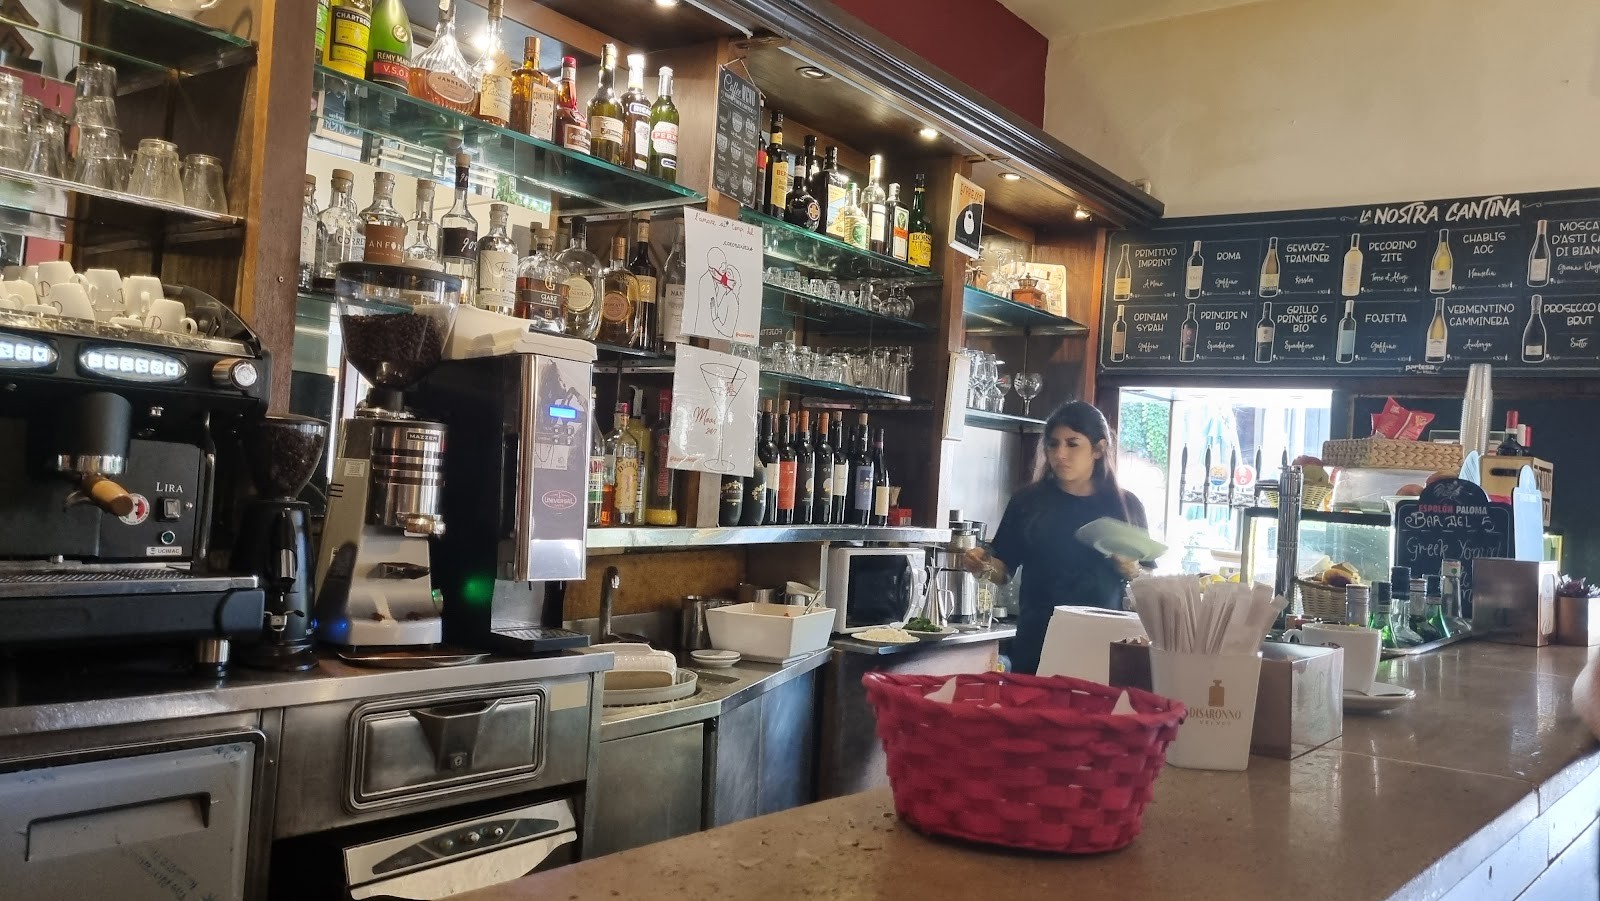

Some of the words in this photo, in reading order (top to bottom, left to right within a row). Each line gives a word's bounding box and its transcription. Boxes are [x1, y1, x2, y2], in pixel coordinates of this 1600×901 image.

[336, 12, 370, 27] CHARTRE
[377, 51, 396, 61] RÉMY
[1359, 210, 1372, 224] LA
[1374, 201, 1439, 225] NOSTRA
[1445, 195, 1521, 222] CANTINA
[1559, 221, 1600, 231] MOSCA
[337, 235, 365, 247] CORRE
[912, 233, 931, 242] BORS
[1462, 232, 1506, 244] CHABLIS
[1551, 233, 1587, 245] D'ASTI
[1368, 240, 1417, 251] PECORINO
[1473, 244, 1494, 255] AOC
[1135, 247, 1178, 258] PRIMITIVO
[1216, 252, 1241, 260] ROMA
[1556, 247, 1569, 257] DI
[1572, 246, 1600, 256] BIAN
[1138, 258, 1172, 268] IMPRINT
[1284, 253, 1330, 263] TRAMINER
[1381, 252, 1402, 263] ZITE
[1286, 305, 1319, 315] GRILLO
[1447, 303, 1515, 314] VERMENTINO
[1543, 303, 1597, 314] PROSECCO
[1133, 312, 1168, 322] OPINIAM
[1200, 311, 1239, 320] PRINCIPE
[1240, 311, 1248, 320] N
[1277, 314, 1318, 324] PRINCIPE
[1365, 313, 1407, 323] FOJETTA
[1566, 315, 1595, 326] BRUT
[1215, 321, 1231, 331] BIO
[1449, 316, 1509, 327] CAMMINERA
[1135, 323, 1164, 332] SYRAH
[1292, 323, 1310, 333] BIO
[409, 433, 438, 441] MAZZER
[156, 481, 183, 493] LIRA
[1456, 505, 1489, 515] PALOMA
[1406, 536, 1450, 562] Greek
[1188, 706, 1242, 720] DISARONNO
